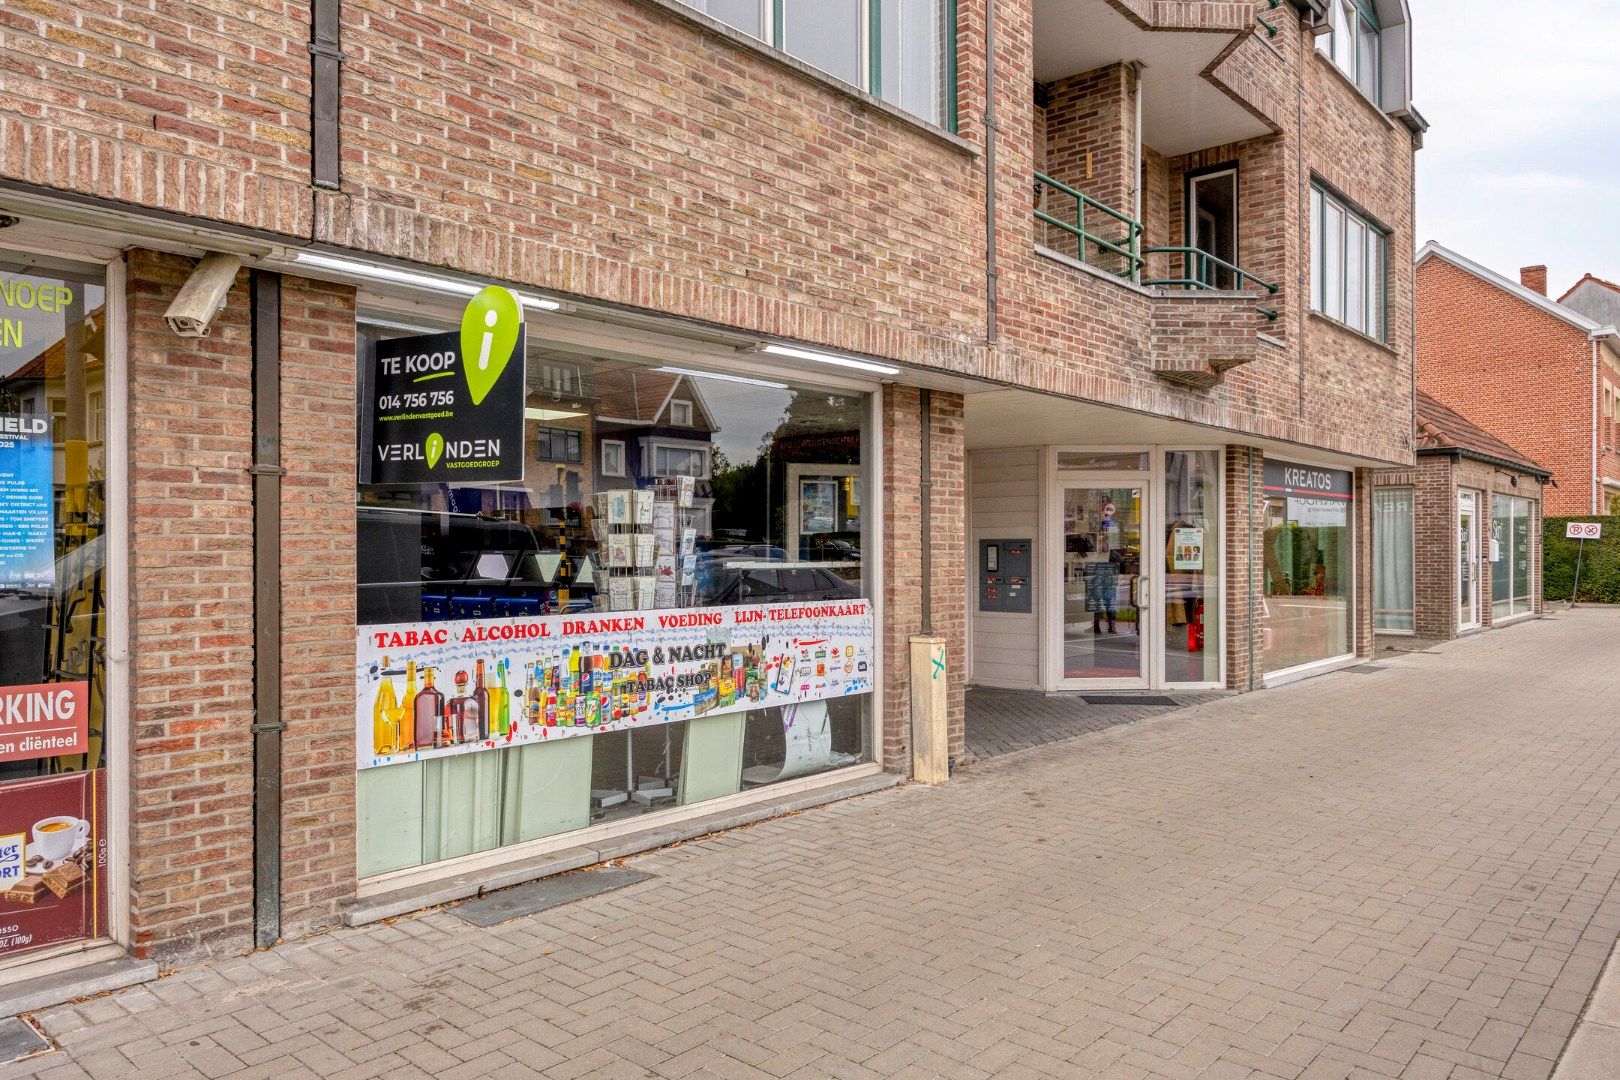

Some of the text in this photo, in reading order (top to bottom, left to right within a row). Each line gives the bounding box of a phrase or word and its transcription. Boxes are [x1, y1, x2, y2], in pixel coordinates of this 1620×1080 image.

[381, 351, 456, 376] TE KOOP
[379, 390, 454, 410] 014 756 756
[378, 410, 454, 422] www.verlindenvastgoed.be
[446, 460, 500, 469] VASTGOEDGROEP
[1284, 467, 1331, 490] KREATOS
[374, 629, 448, 649] TABAC
[461, 622, 551, 643] ALCOHOL
[562, 616, 646, 636] DRANKEN
[658, 612, 723, 629] VOEDING
[769, 604, 866, 622] TELEFOONKAART
[608, 642, 727, 670] DAG & NACHT
[627, 671, 712, 694] TABAC SHOP
[19, 731, 78, 752] cliënteel
